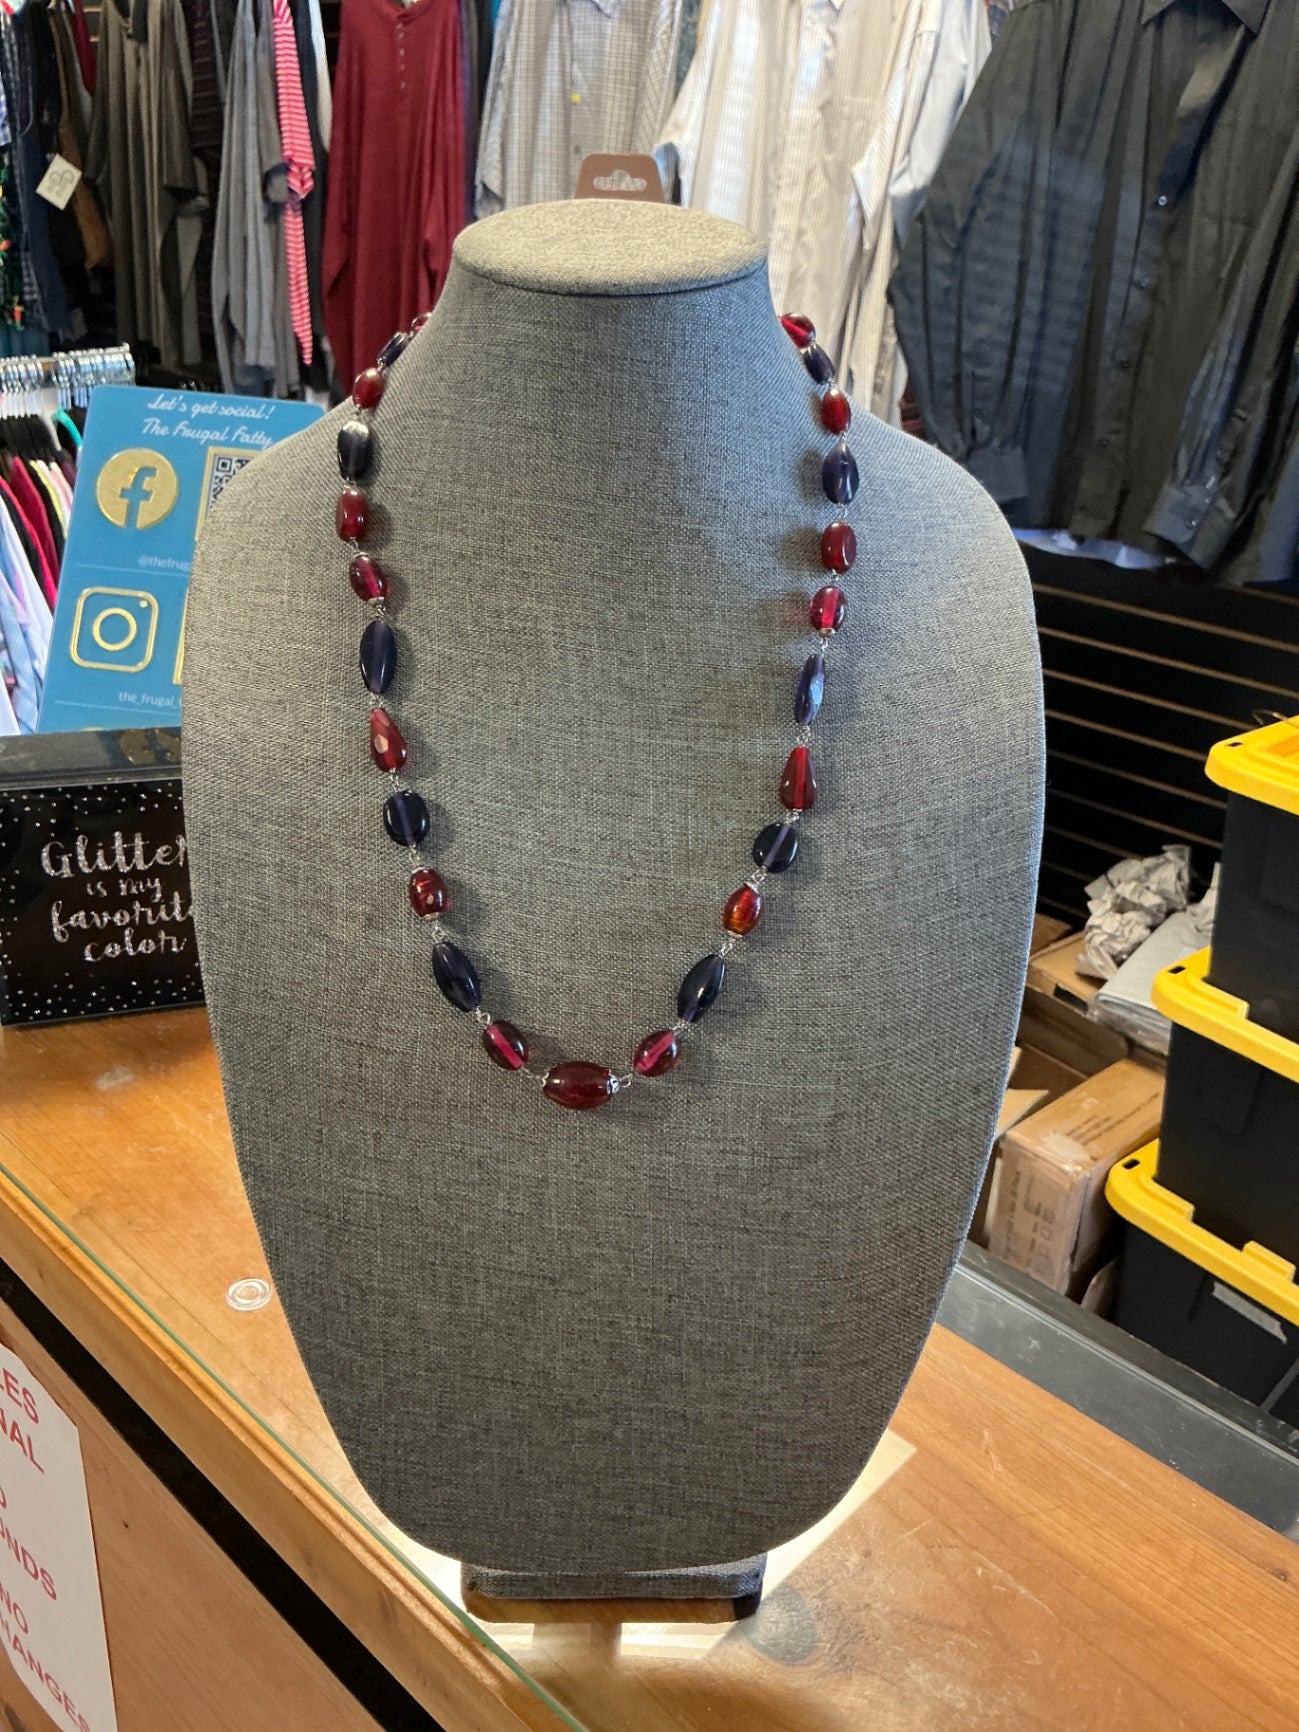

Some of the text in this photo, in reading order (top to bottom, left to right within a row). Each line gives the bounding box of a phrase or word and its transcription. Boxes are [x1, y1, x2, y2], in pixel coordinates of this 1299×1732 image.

[147, 393, 275, 419] Let's get social!
[142, 417, 273, 449] The Frugal Fatty
[119, 691, 182, 709] the_frugal_
[87, 876, 162, 903] is my
[51, 891, 193, 943] favorit
[84, 927, 187, 962] color
[0, 1368, 39, 1424] ES
[0, 1517, 57, 1600] NDS
